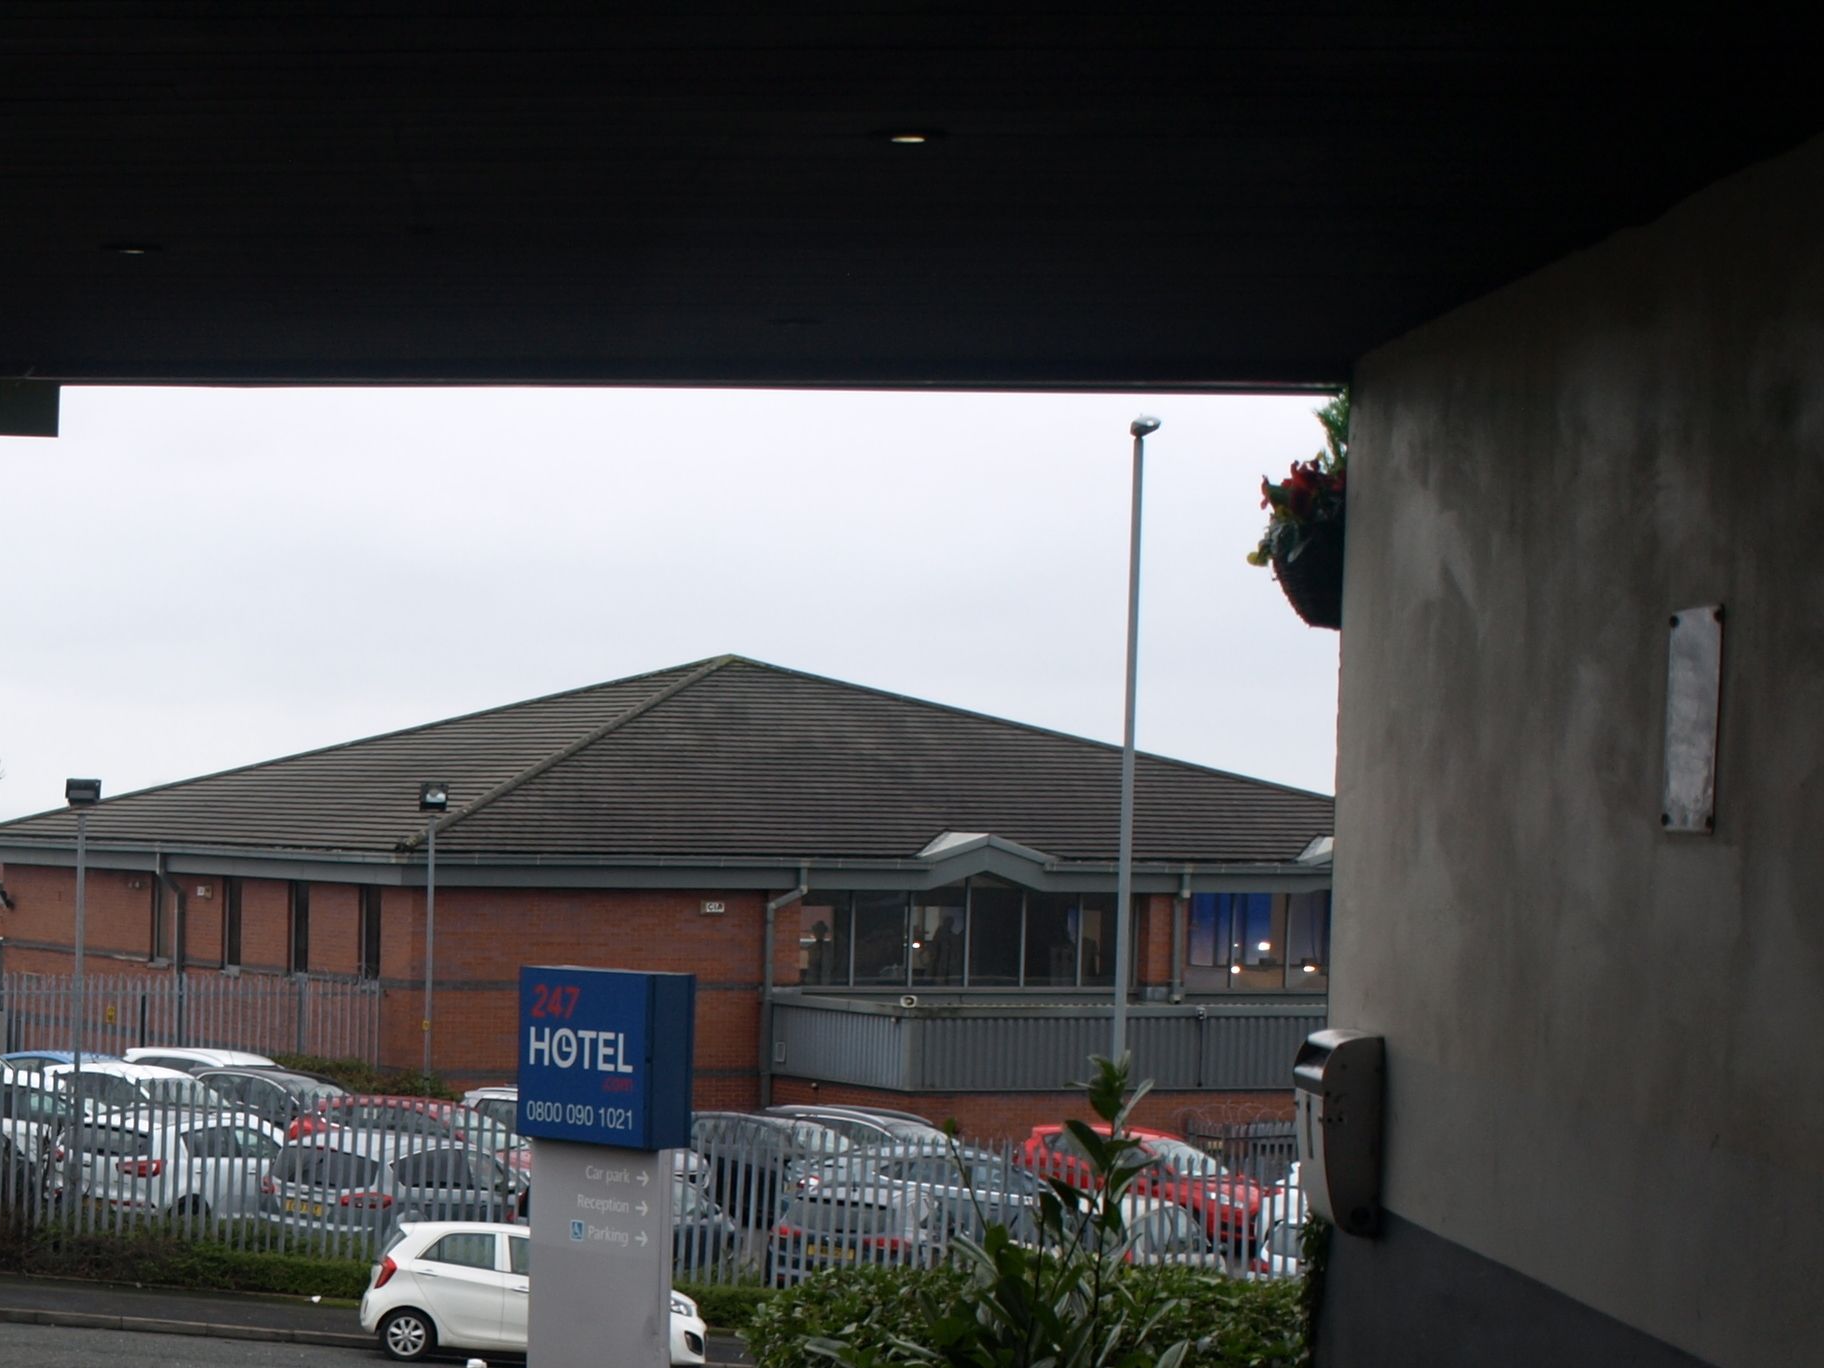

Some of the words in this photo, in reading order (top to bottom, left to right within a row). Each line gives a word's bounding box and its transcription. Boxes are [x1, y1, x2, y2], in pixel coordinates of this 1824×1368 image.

[531, 984, 581, 1019] 247
[529, 1026, 633, 1073] HOTEL
[527, 1101, 561, 1122] 0800
[566, 1104, 594, 1126] 090
[599, 1107, 632, 1130] 1021
[585, 1165, 603, 1179] Car
[606, 1168, 630, 1184] park
[577, 1194, 629, 1214] Reception
[588, 1225, 629, 1247] Parking
